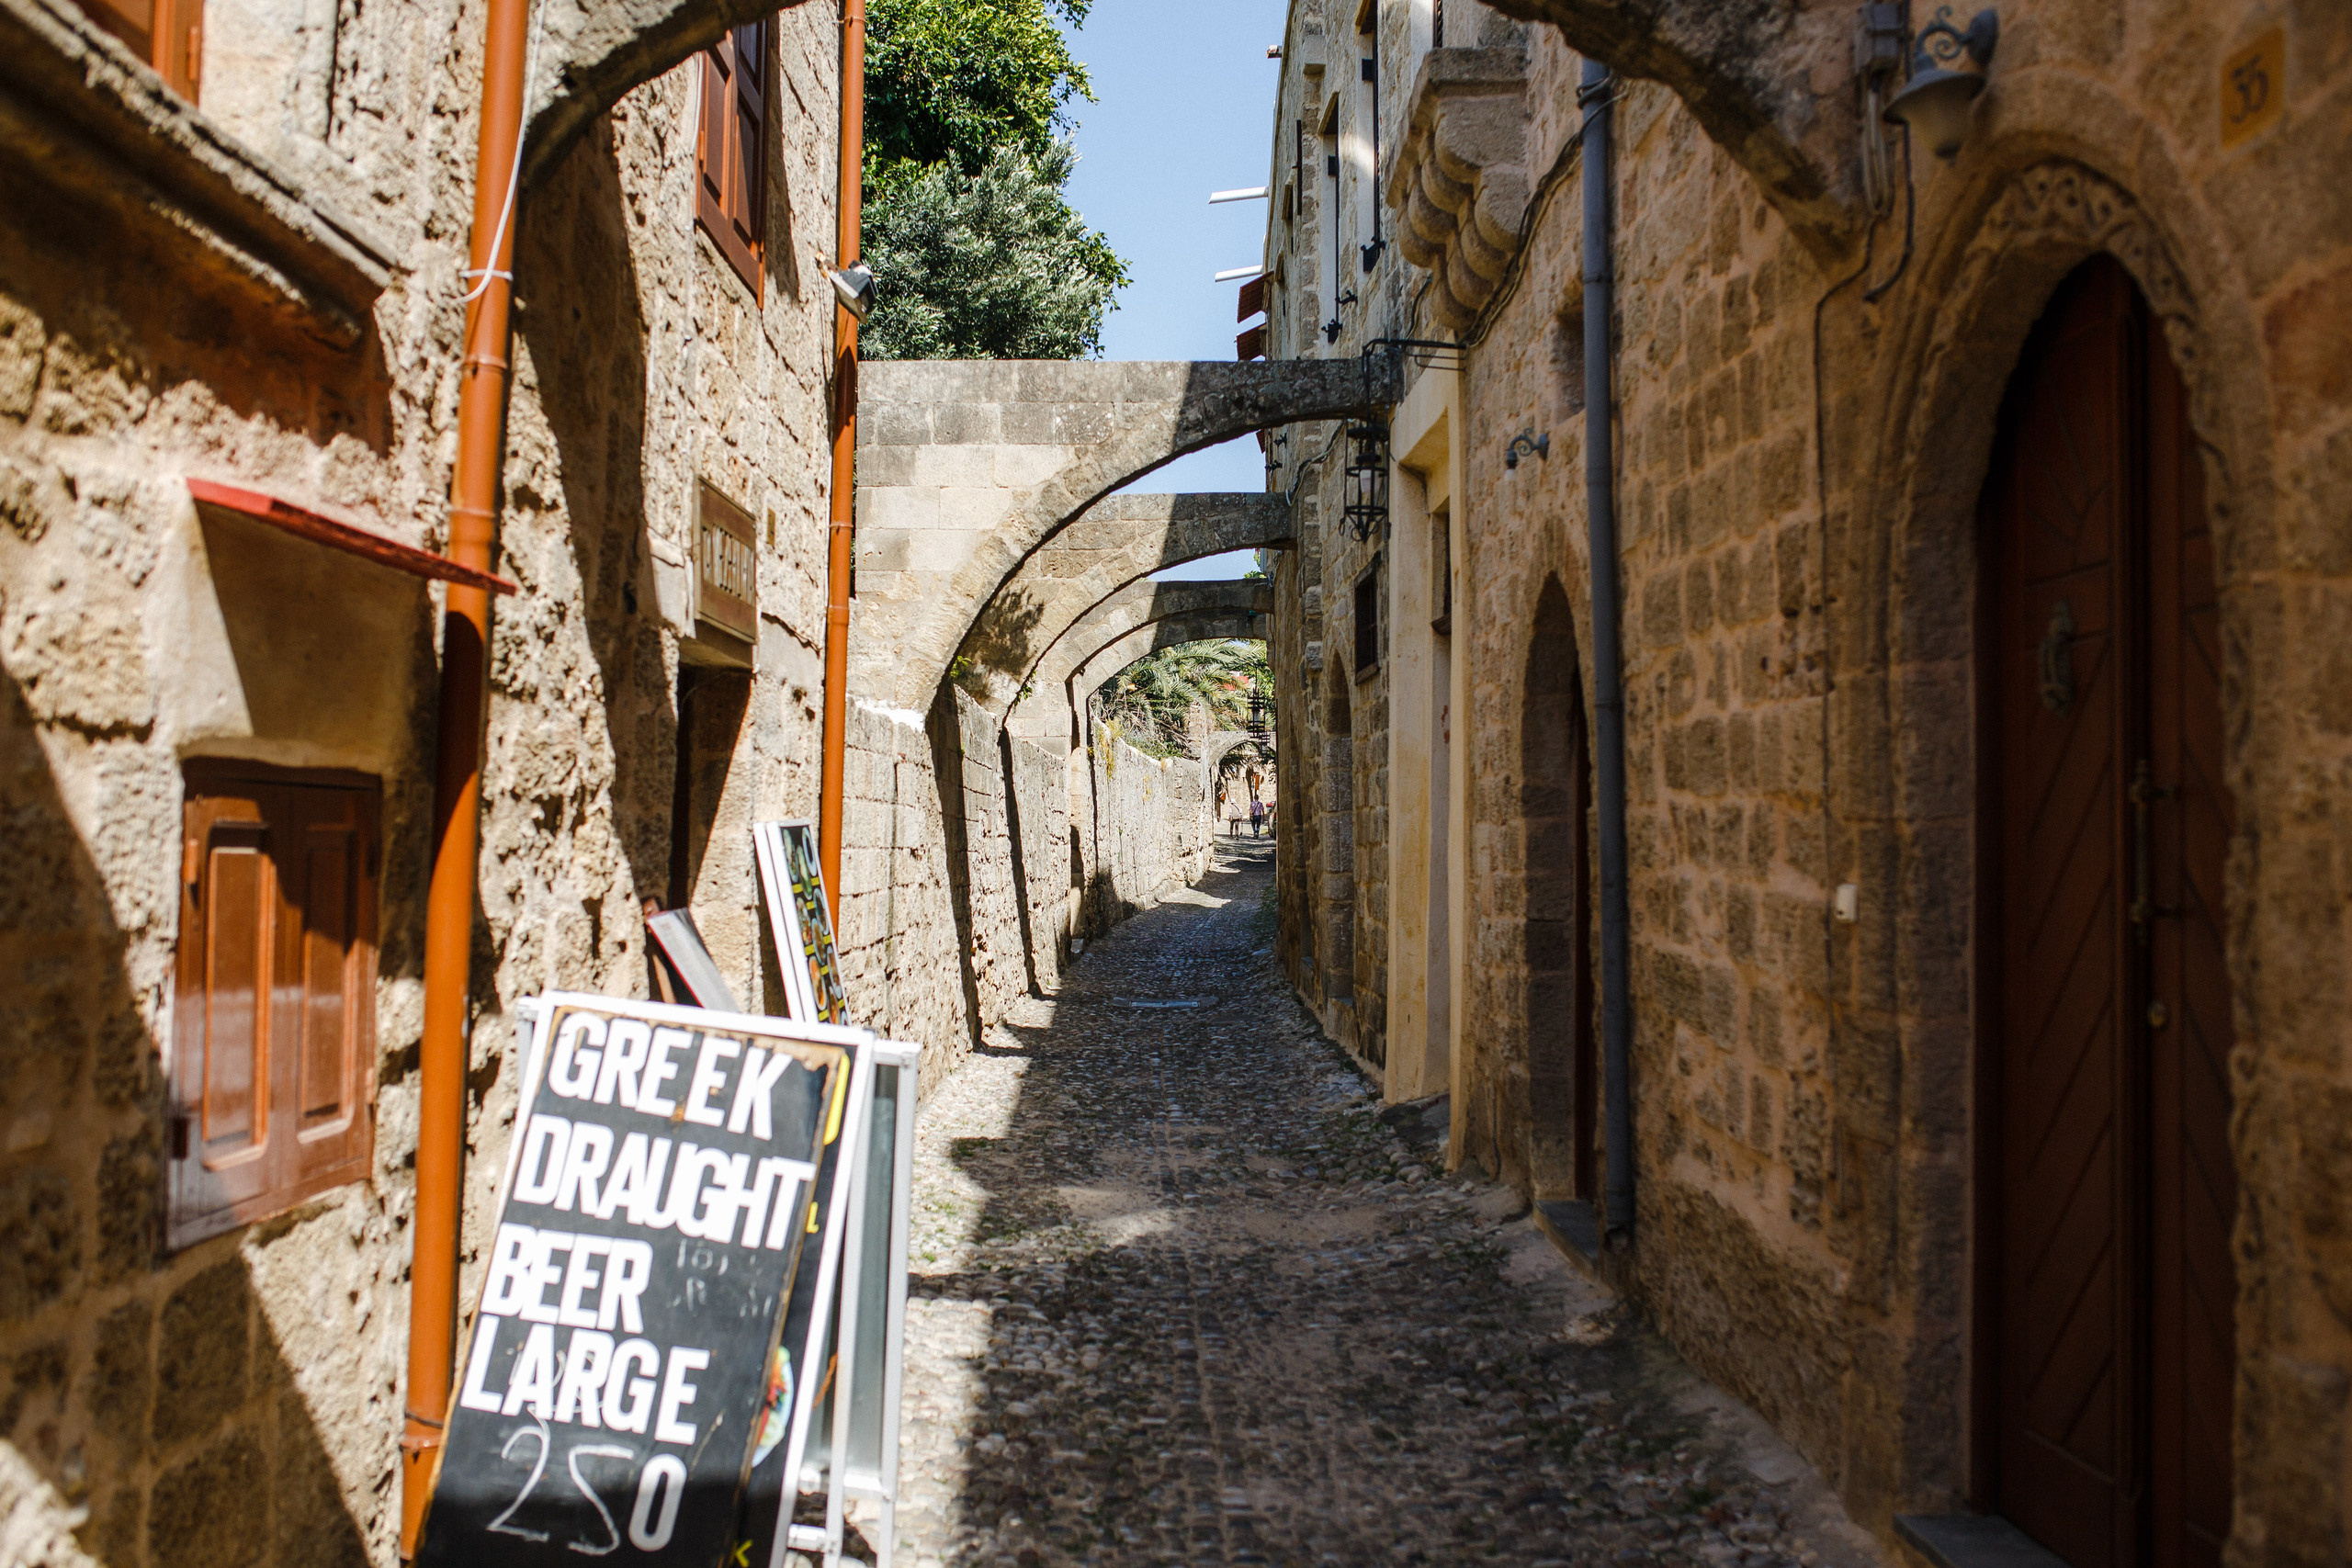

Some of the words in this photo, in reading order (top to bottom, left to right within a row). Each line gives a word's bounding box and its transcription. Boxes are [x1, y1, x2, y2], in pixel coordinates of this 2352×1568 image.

[550, 1012, 793, 1140] GREEK
[513, 1114, 817, 1250] DRAUGHT
[480, 1223, 652, 1334] BEER
[459, 1314, 710, 1445] LARGE
